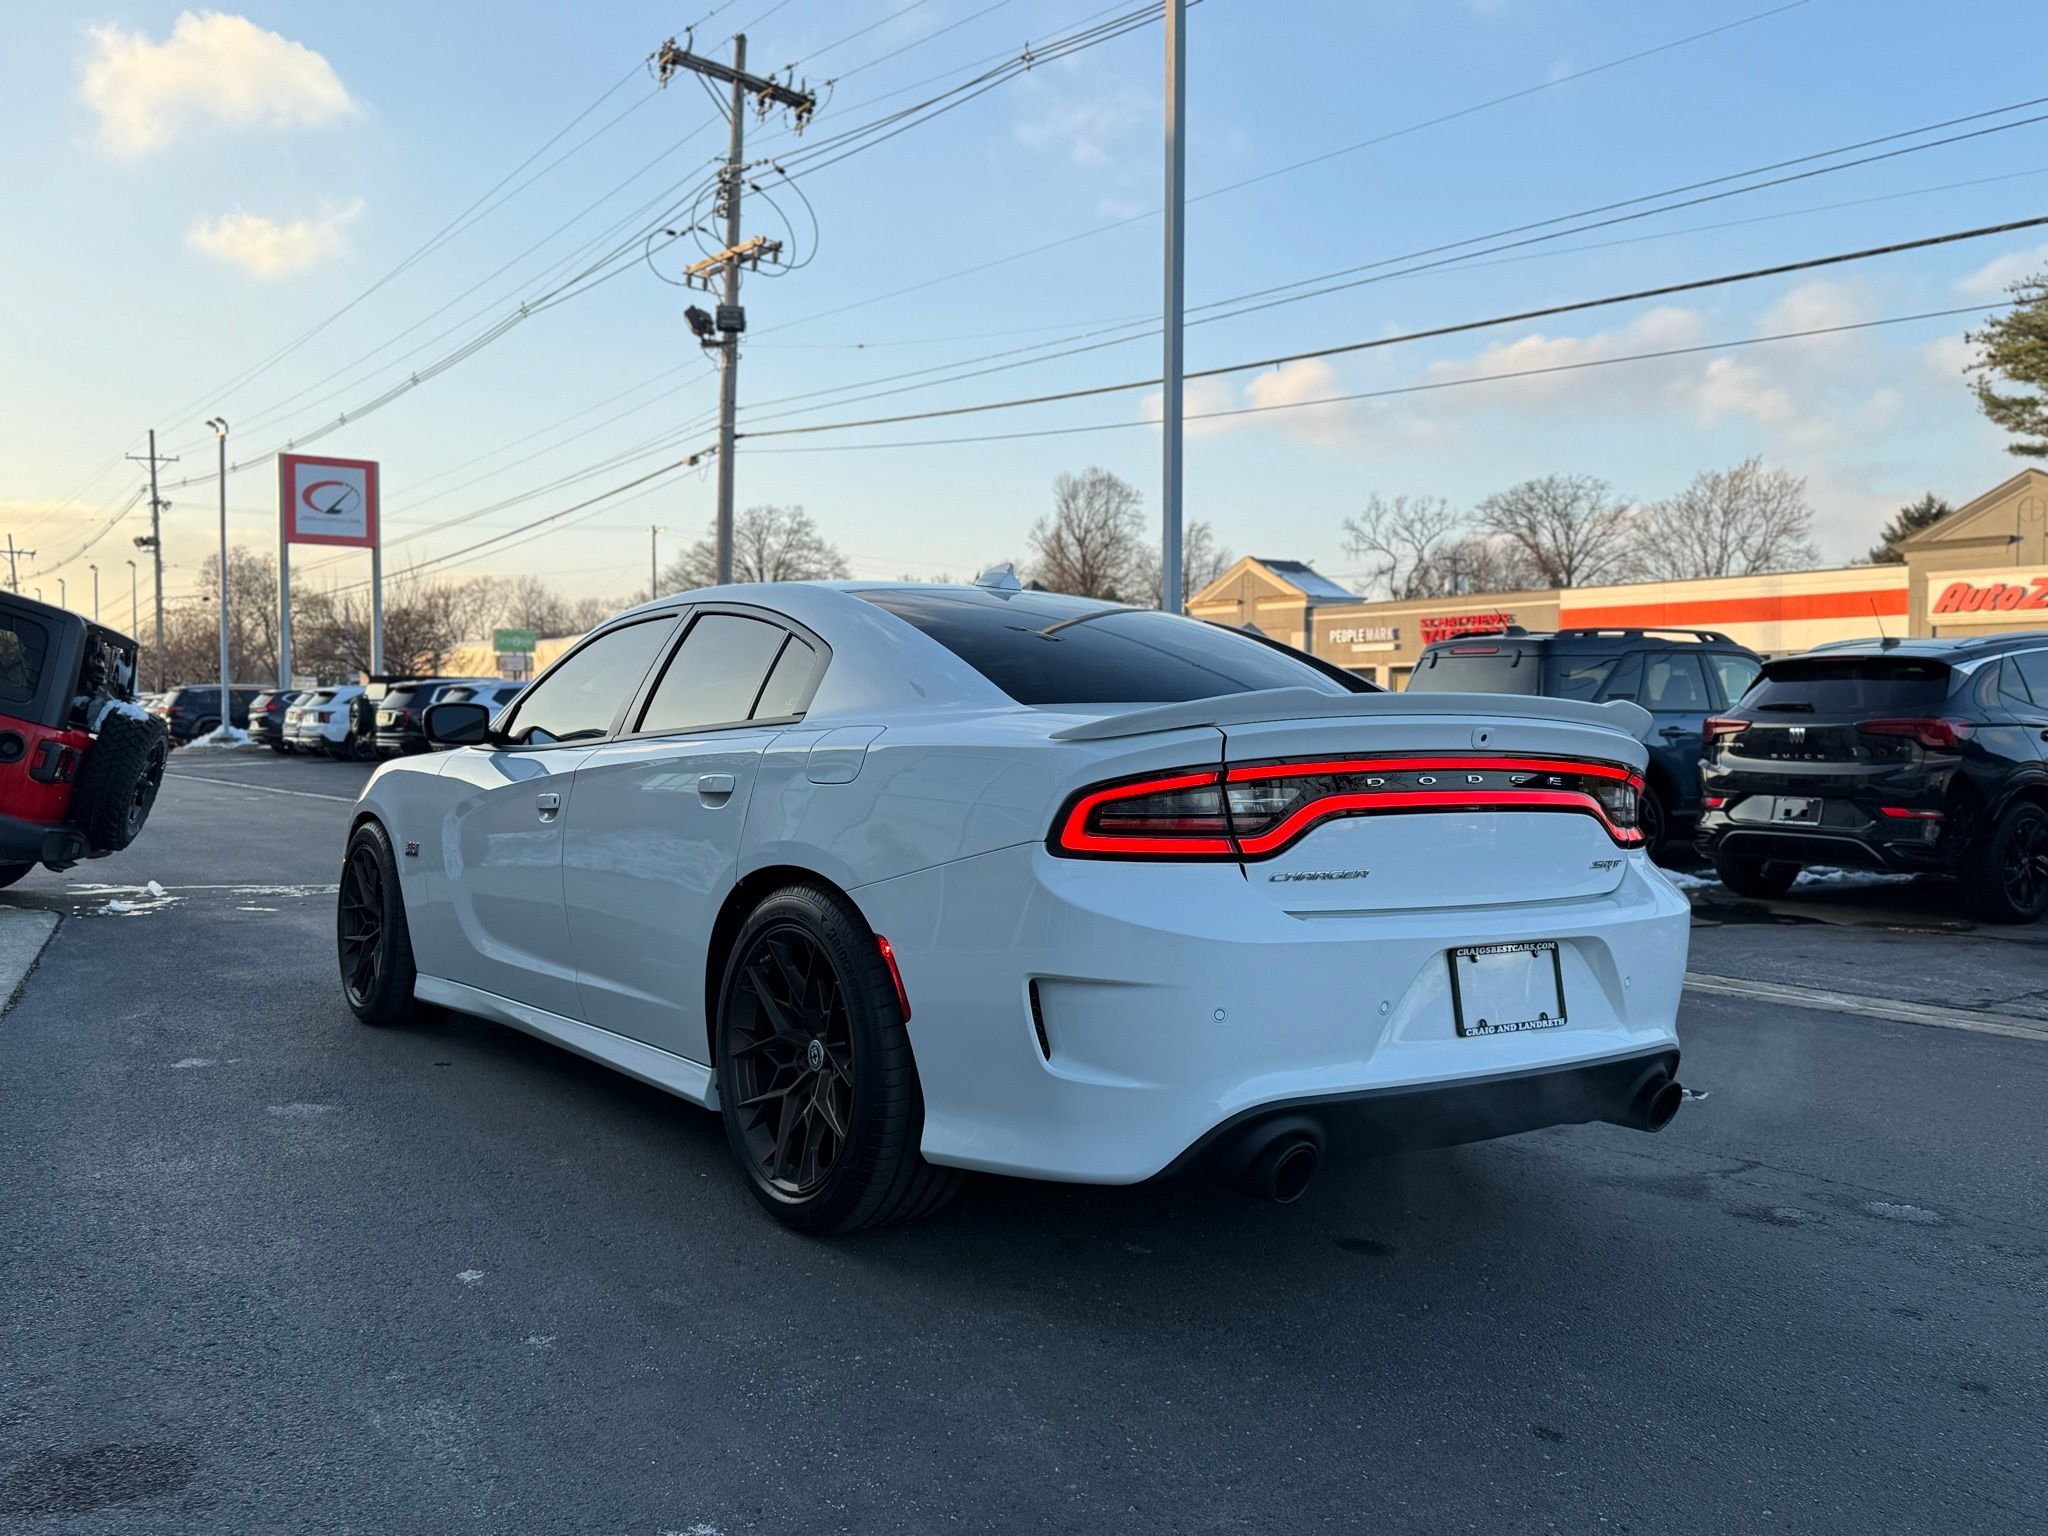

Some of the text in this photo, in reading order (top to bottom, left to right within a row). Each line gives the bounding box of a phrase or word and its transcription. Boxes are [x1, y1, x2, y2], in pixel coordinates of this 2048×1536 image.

[1366, 774, 1562, 787] DODGE
[1589, 859, 1622, 872] SRT
[1268, 869, 1369, 882] CHARGER
[1457, 942, 1556, 956] CRAIGSBESTCARS.COM
[1465, 1018, 1565, 1037] CRAIG AND LANDRETH
